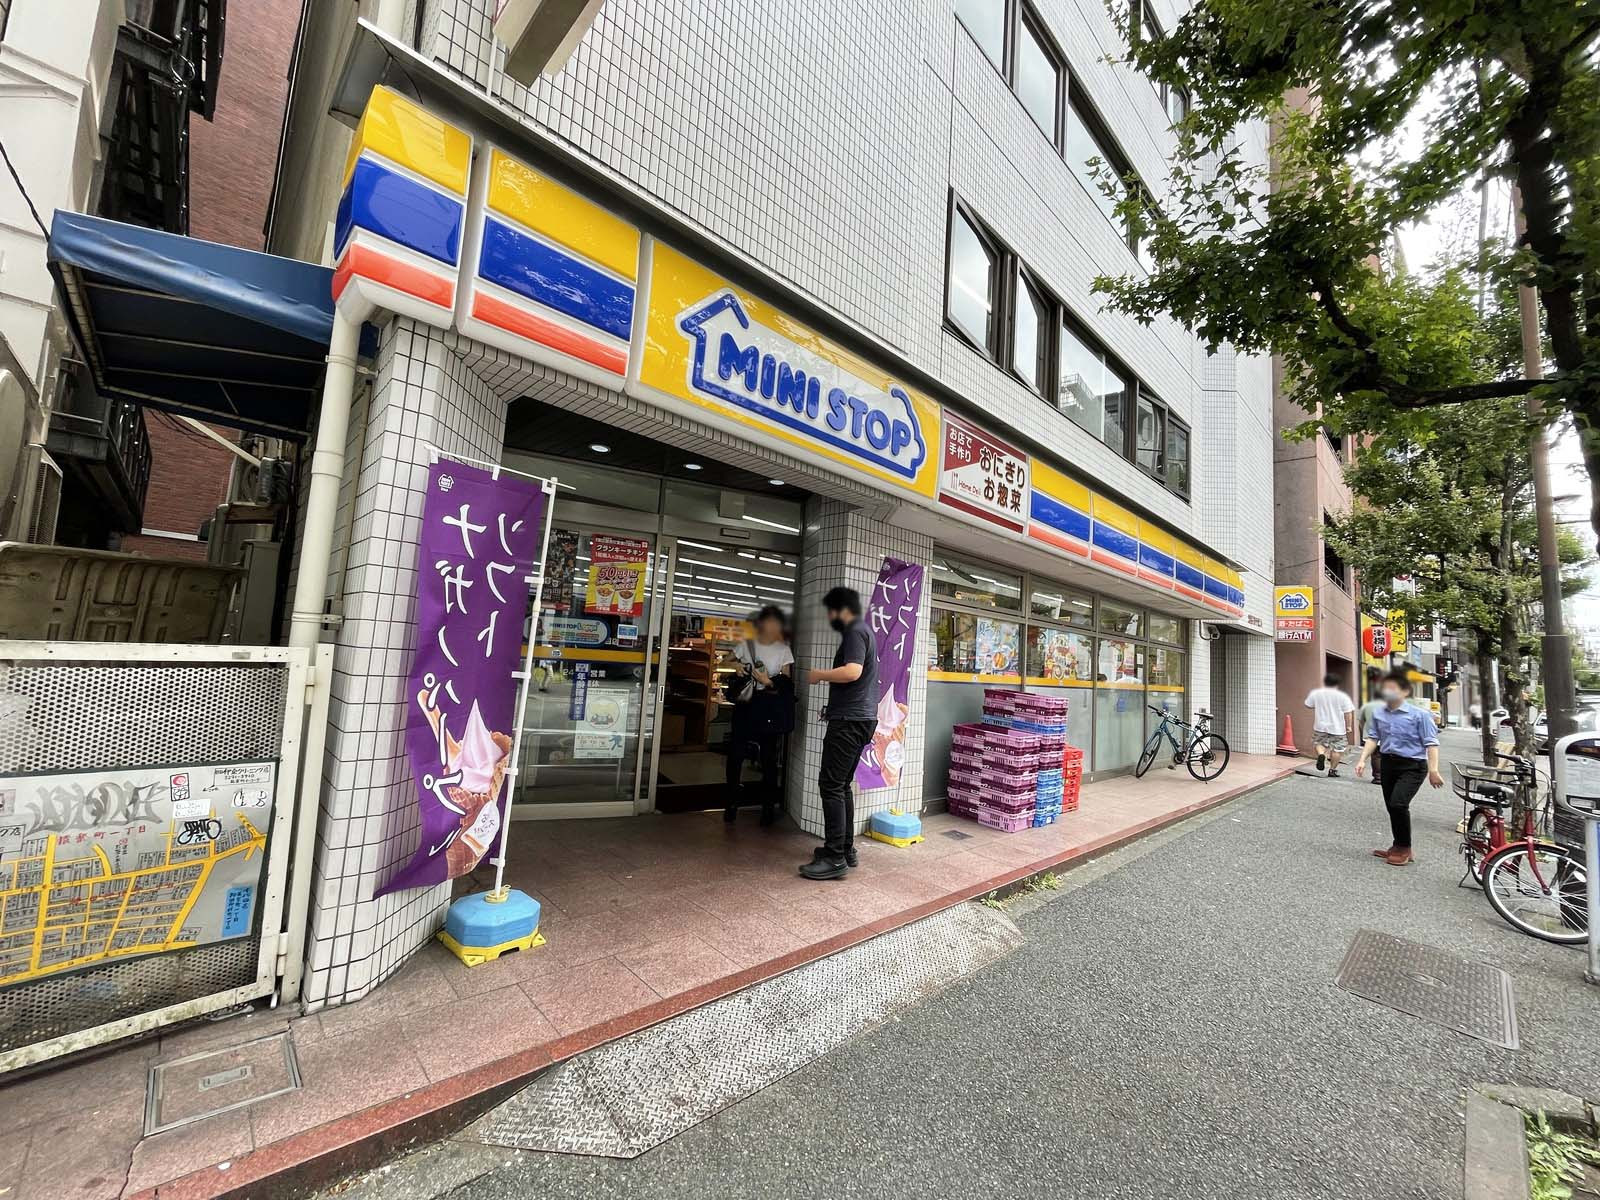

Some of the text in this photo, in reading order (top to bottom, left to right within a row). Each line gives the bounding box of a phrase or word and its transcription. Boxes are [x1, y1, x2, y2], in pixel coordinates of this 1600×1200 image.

[718, 332, 912, 457] MINI STOP
[949, 427, 973, 449] お店で
[949, 442, 972, 463] 手作り
[980, 446, 1025, 489] おにぎり
[959, 480, 972, 492] Home
[983, 476, 1021, 513] お惣菜
[596, 544, 645, 557] クランキーチキン
[1278, 631, 1312, 640] 銀行ATM
